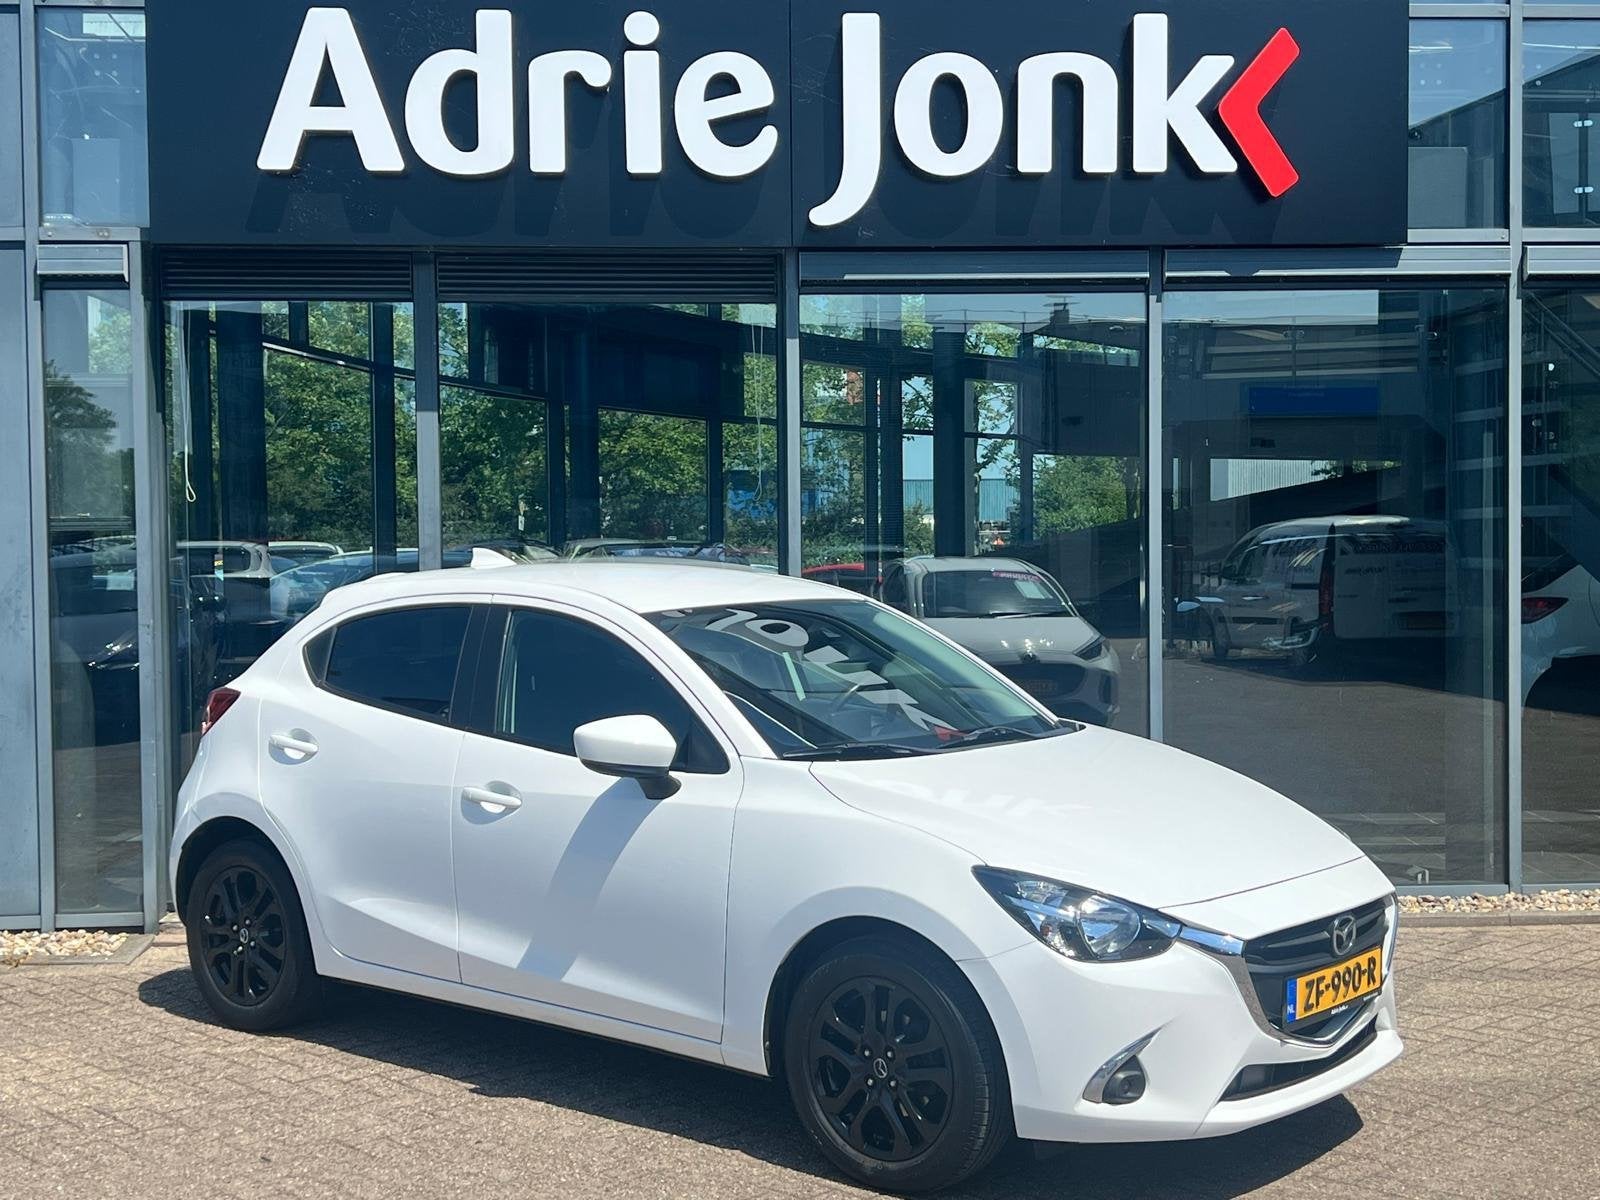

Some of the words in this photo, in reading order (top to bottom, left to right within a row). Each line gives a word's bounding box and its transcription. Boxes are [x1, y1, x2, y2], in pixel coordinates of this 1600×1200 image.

[257, 7, 778, 178] Adrie
[808, 12, 1238, 227] Jonk
[1287, 1003, 1295, 1015] NL
[1303, 956, 1377, 1013] ZF-990-R
